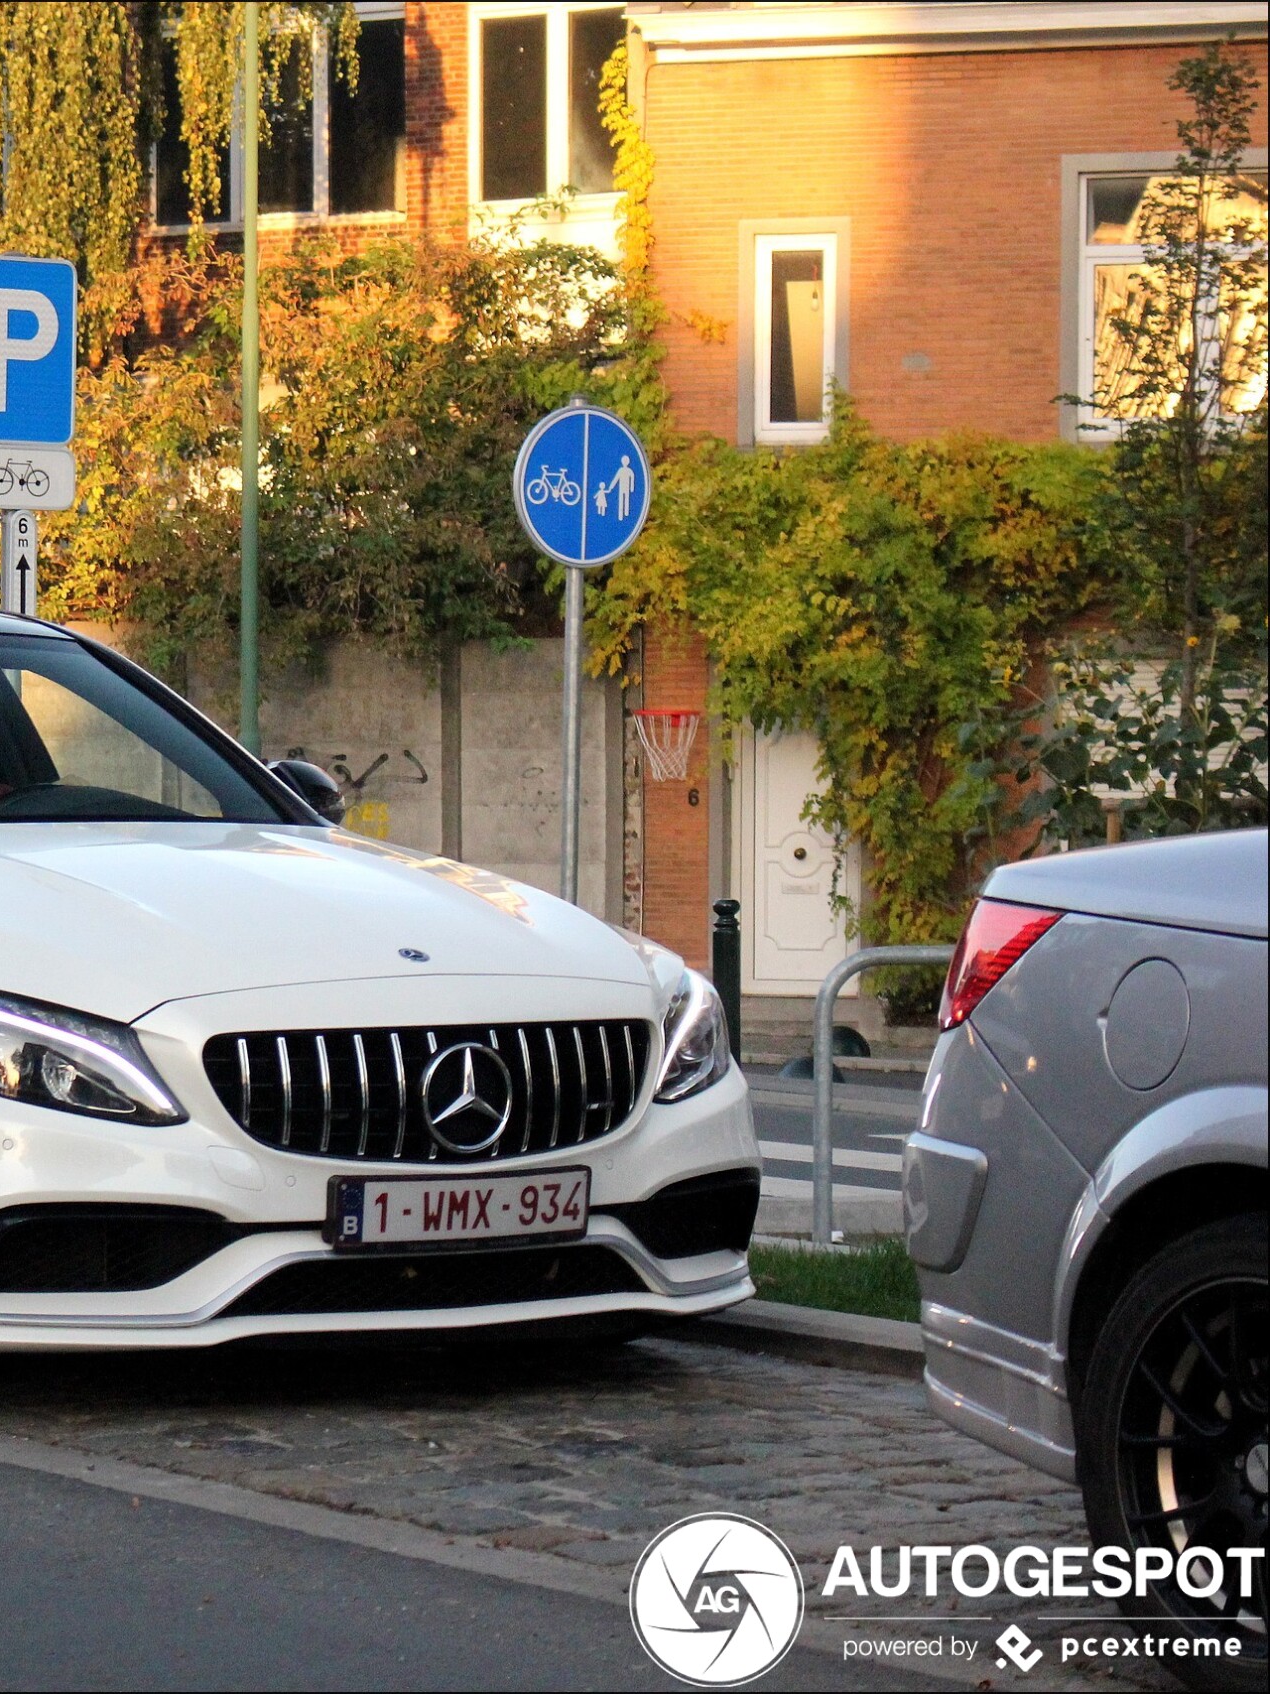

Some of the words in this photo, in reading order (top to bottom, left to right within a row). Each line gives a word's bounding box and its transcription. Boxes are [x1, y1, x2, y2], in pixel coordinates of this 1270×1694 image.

[17, 517, 29, 535] 6
[17, 537, 29, 548] m
[688, 788, 700, 807] 6
[374, 1180, 583, 1235] 1-WMX-934
[342, 1215, 359, 1236] B
